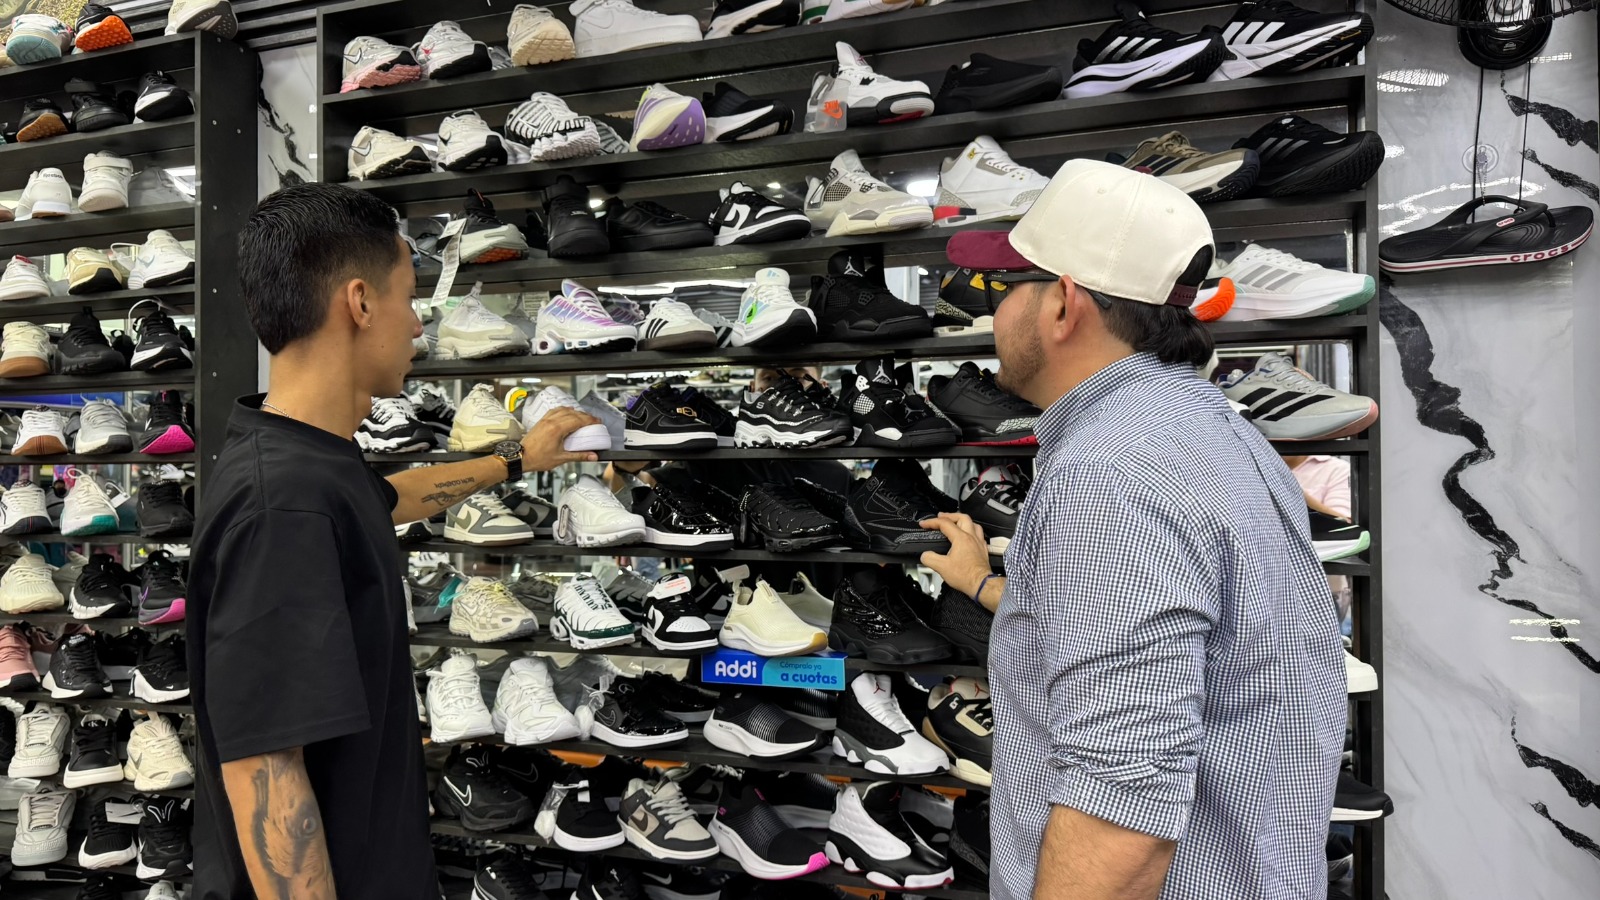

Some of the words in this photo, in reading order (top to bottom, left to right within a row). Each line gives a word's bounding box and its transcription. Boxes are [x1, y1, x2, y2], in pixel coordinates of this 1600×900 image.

[1510, 245, 1569, 262] crocs
[715, 660, 757, 678] Addi
[780, 661, 813, 669] Cómpralo
[780, 672, 789, 681] a
[792, 672, 837, 684] cuotas
